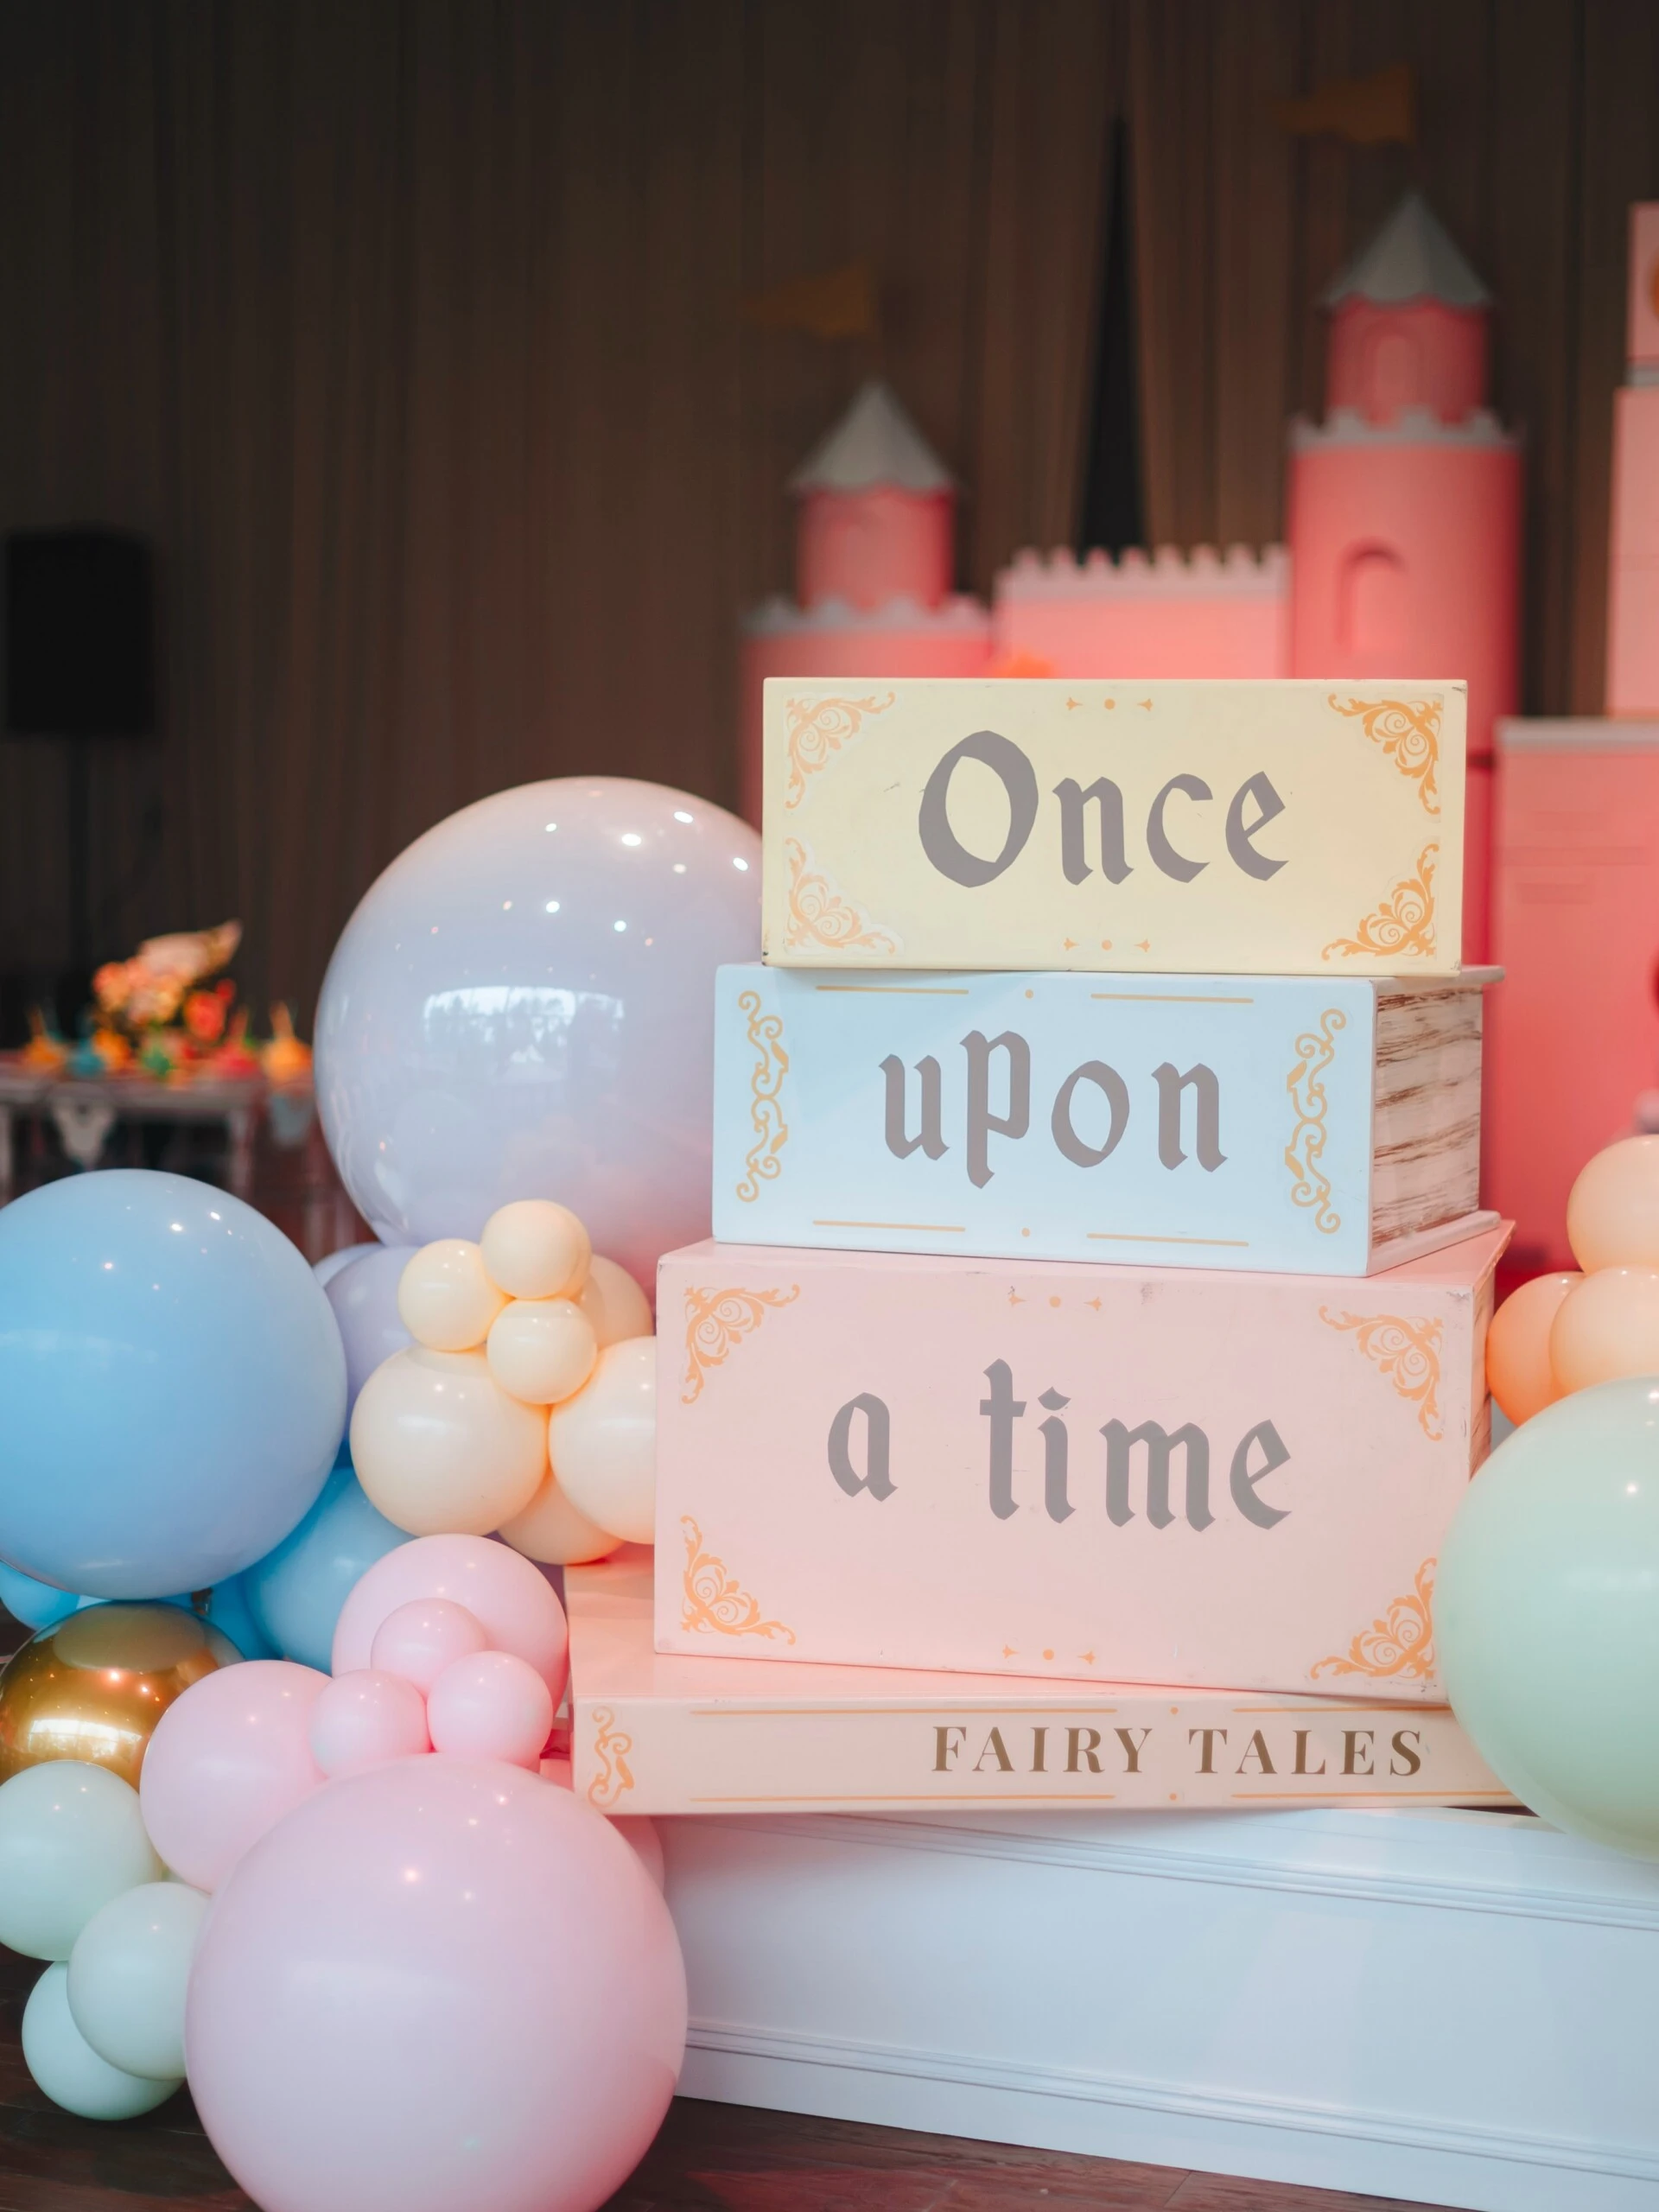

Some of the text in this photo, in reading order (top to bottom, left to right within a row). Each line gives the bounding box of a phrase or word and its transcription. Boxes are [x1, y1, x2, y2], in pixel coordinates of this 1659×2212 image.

[918, 730, 1289, 888] Once
[879, 1030, 1229, 1189] upon
[828, 1359, 1293, 1532] a time
[932, 1726, 1424, 1777] FAIRY TALES
